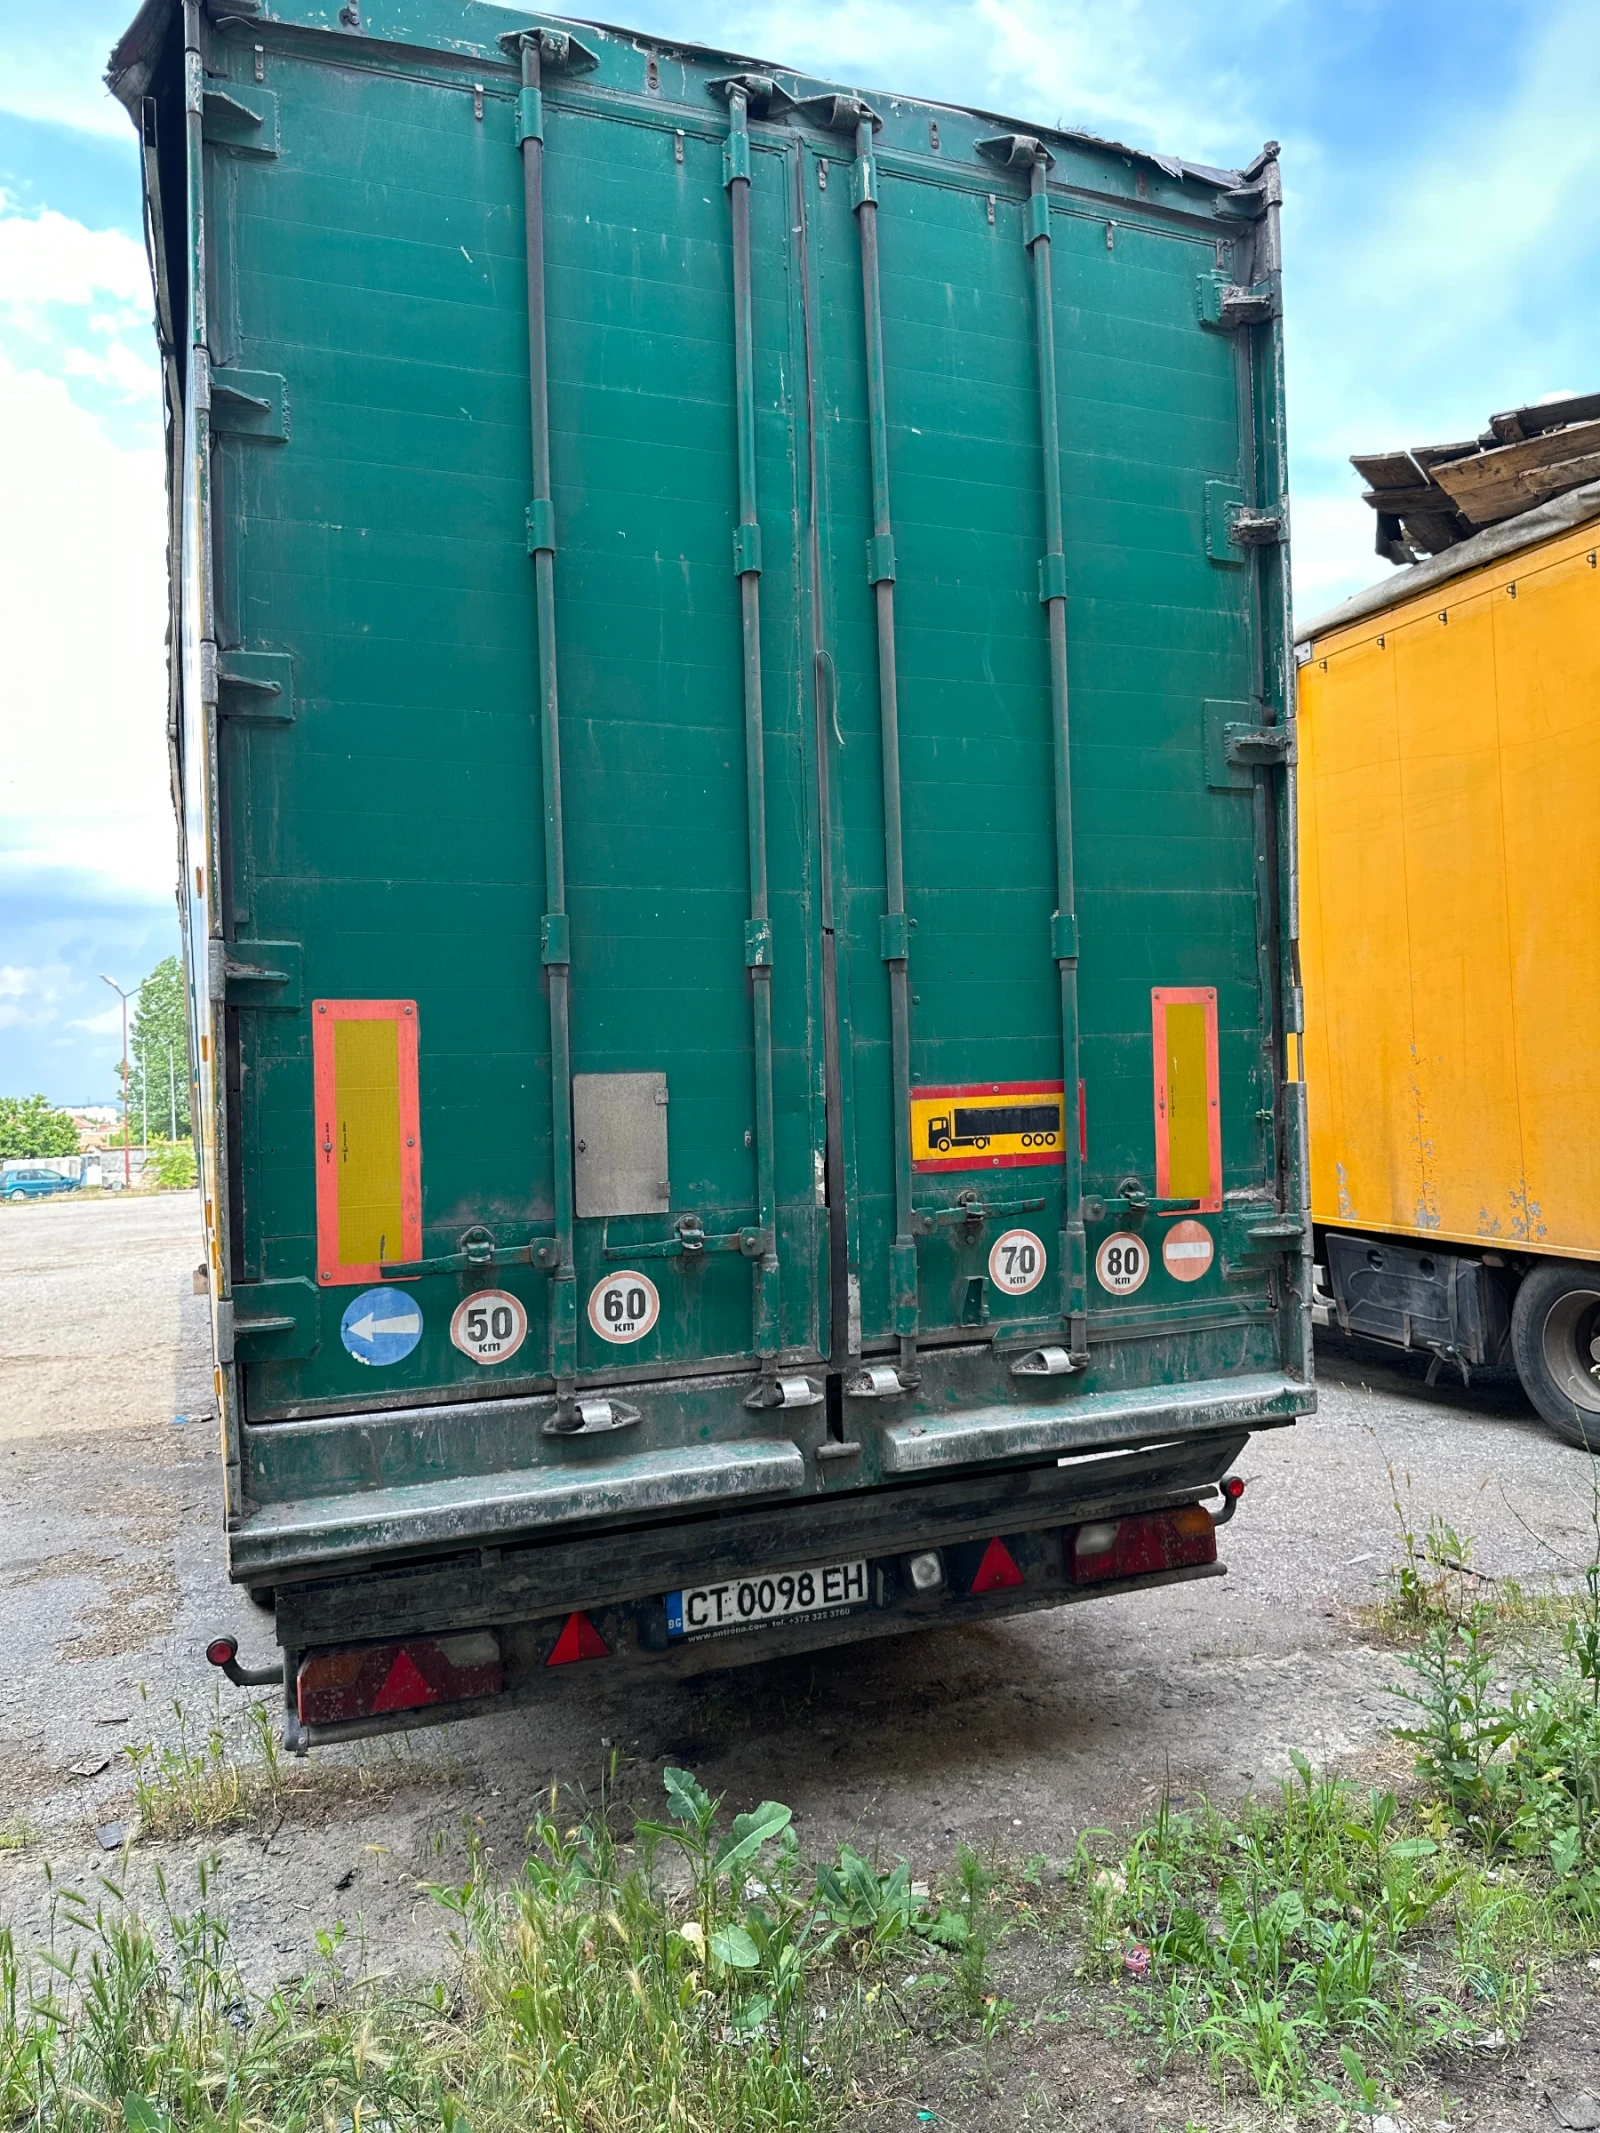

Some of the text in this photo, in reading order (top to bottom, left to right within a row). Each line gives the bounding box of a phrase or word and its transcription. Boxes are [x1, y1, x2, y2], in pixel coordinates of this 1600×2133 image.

[1001, 1245, 1036, 1275] 70
[1107, 1247, 1140, 1276] 80
[604, 1288, 646, 1322] 60
[467, 1306, 513, 1342] 50
[737, 1572, 816, 1617] 0098
[823, 1564, 864, 1603] EH
[667, 1618, 682, 1630] BG
[788, 1614, 810, 1625] +372
[811, 1611, 828, 1621] 322
